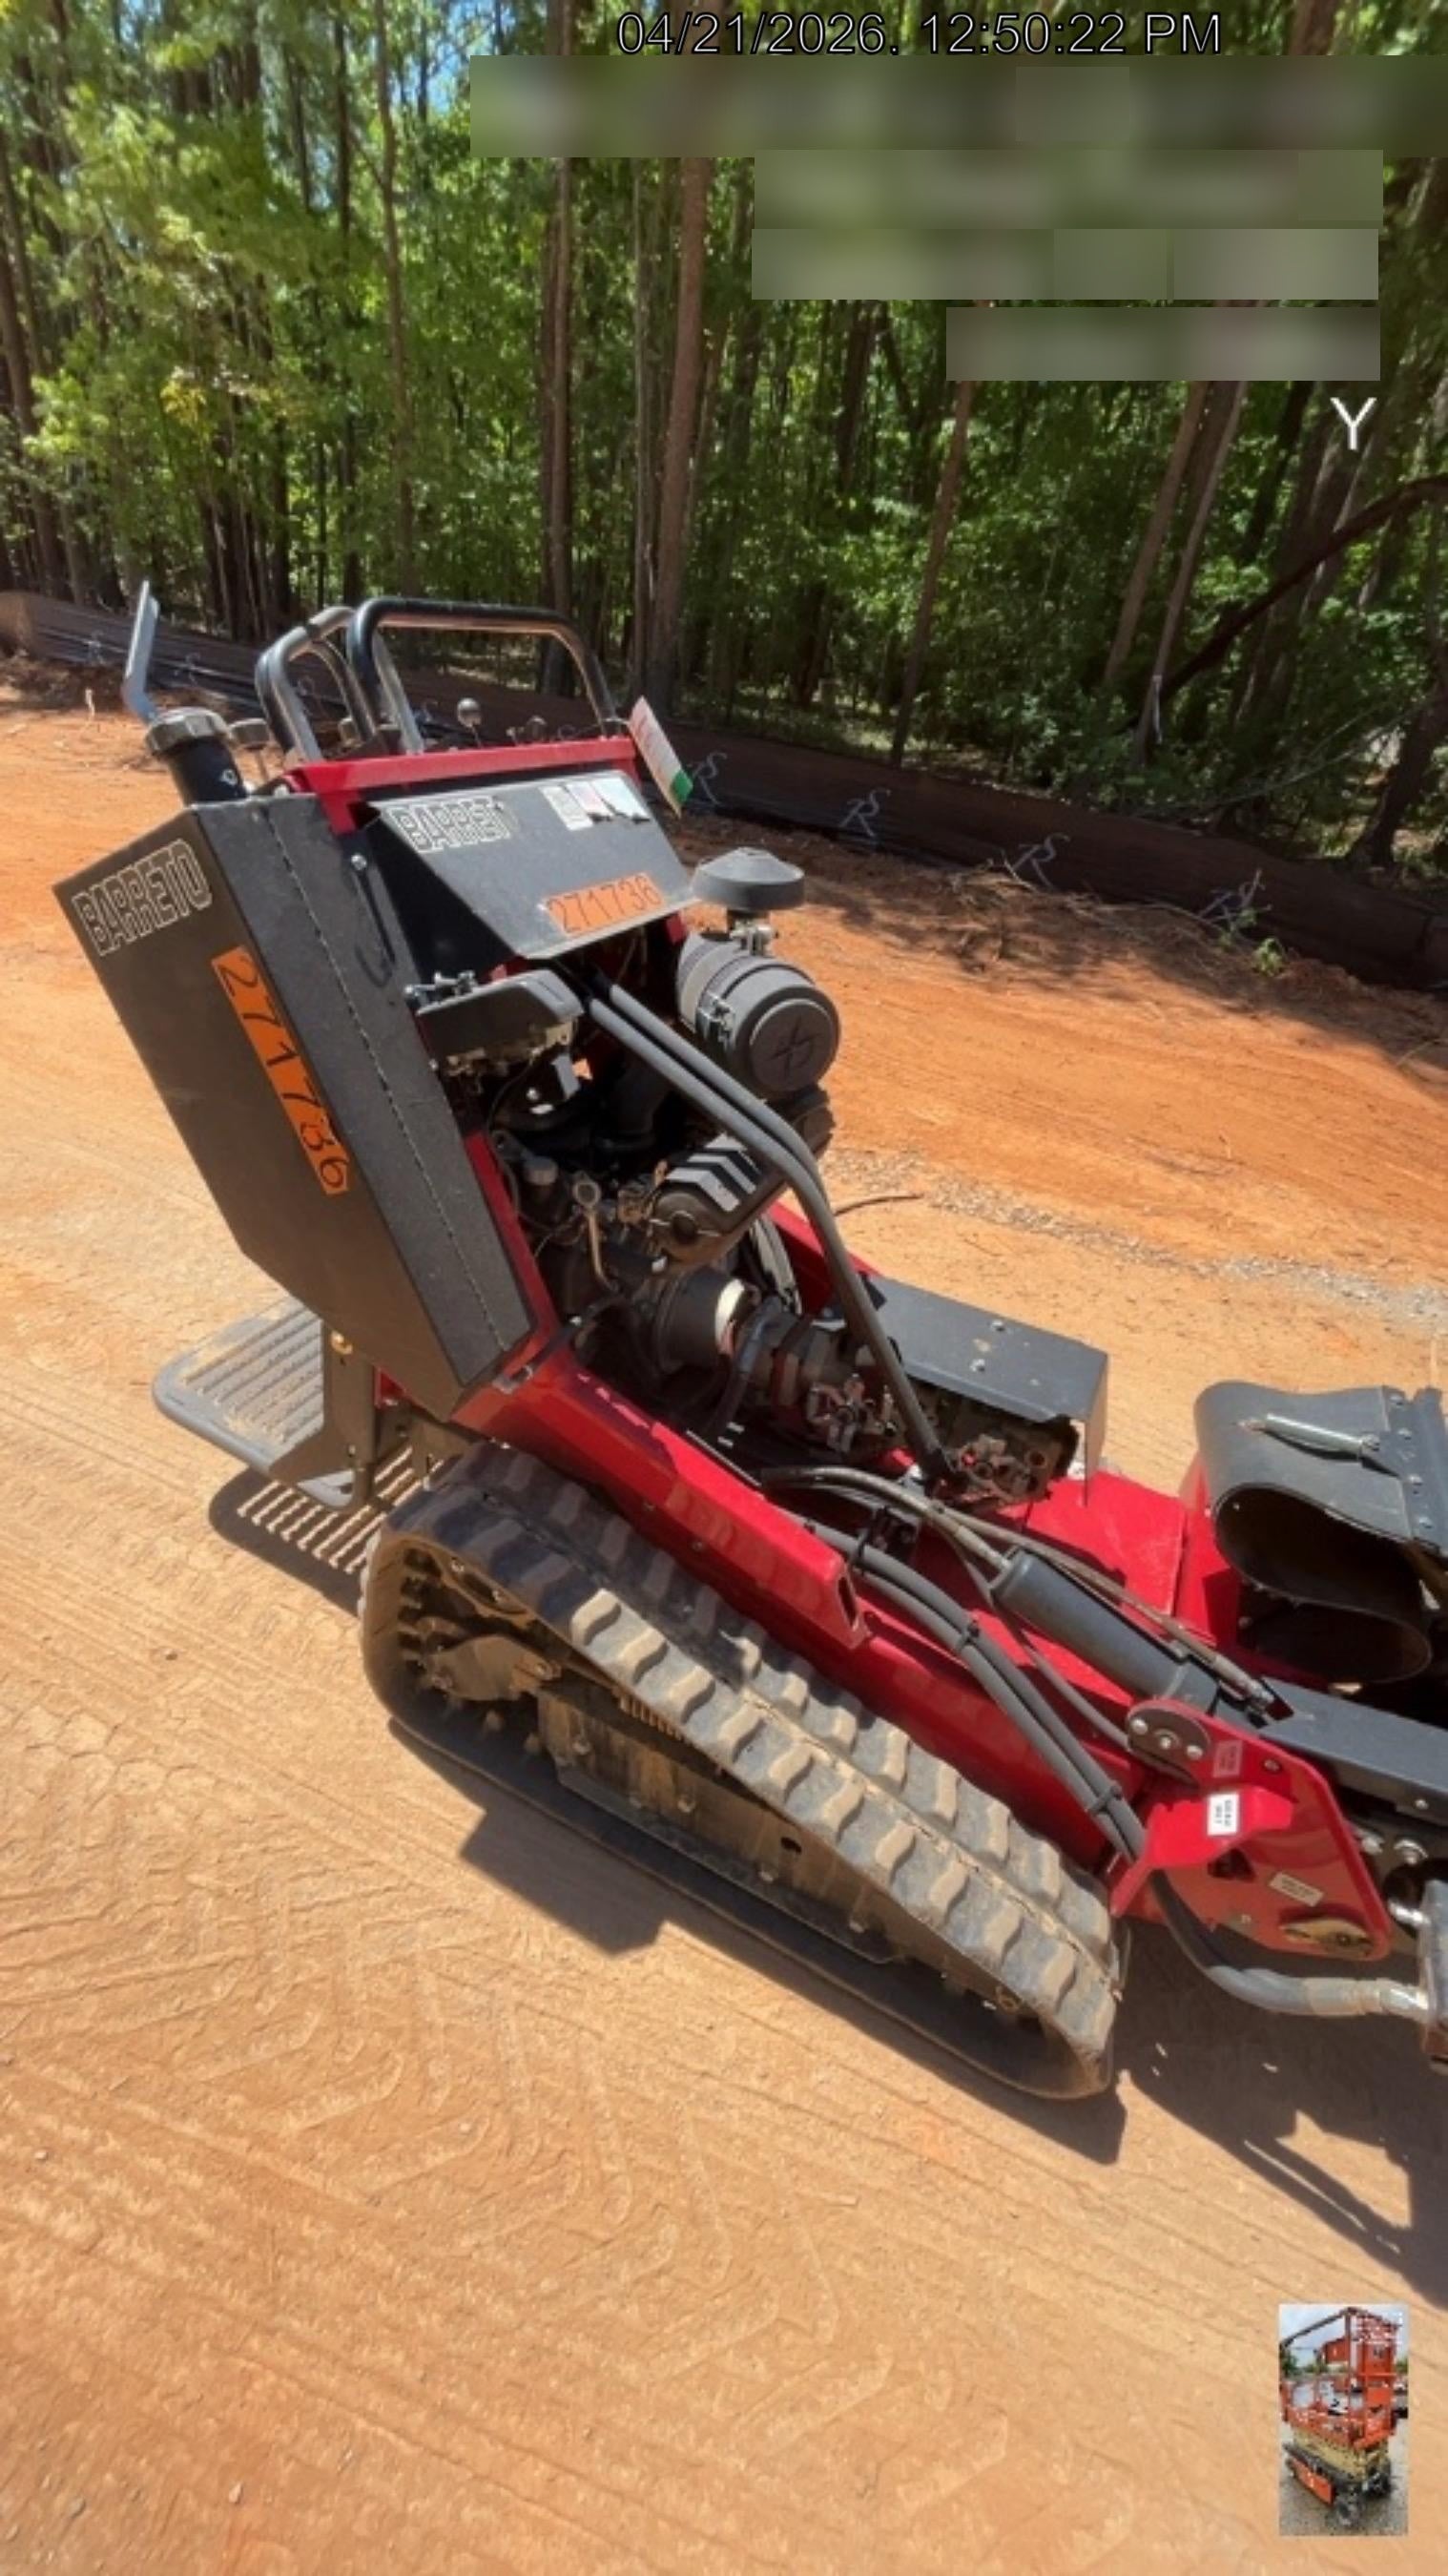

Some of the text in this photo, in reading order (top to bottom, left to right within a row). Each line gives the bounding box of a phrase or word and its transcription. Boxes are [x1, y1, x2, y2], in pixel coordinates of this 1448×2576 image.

[385, 796, 515, 853] BARRET
[72, 839, 212, 956] BARRETO
[217, 956, 349, 1189] 271736
